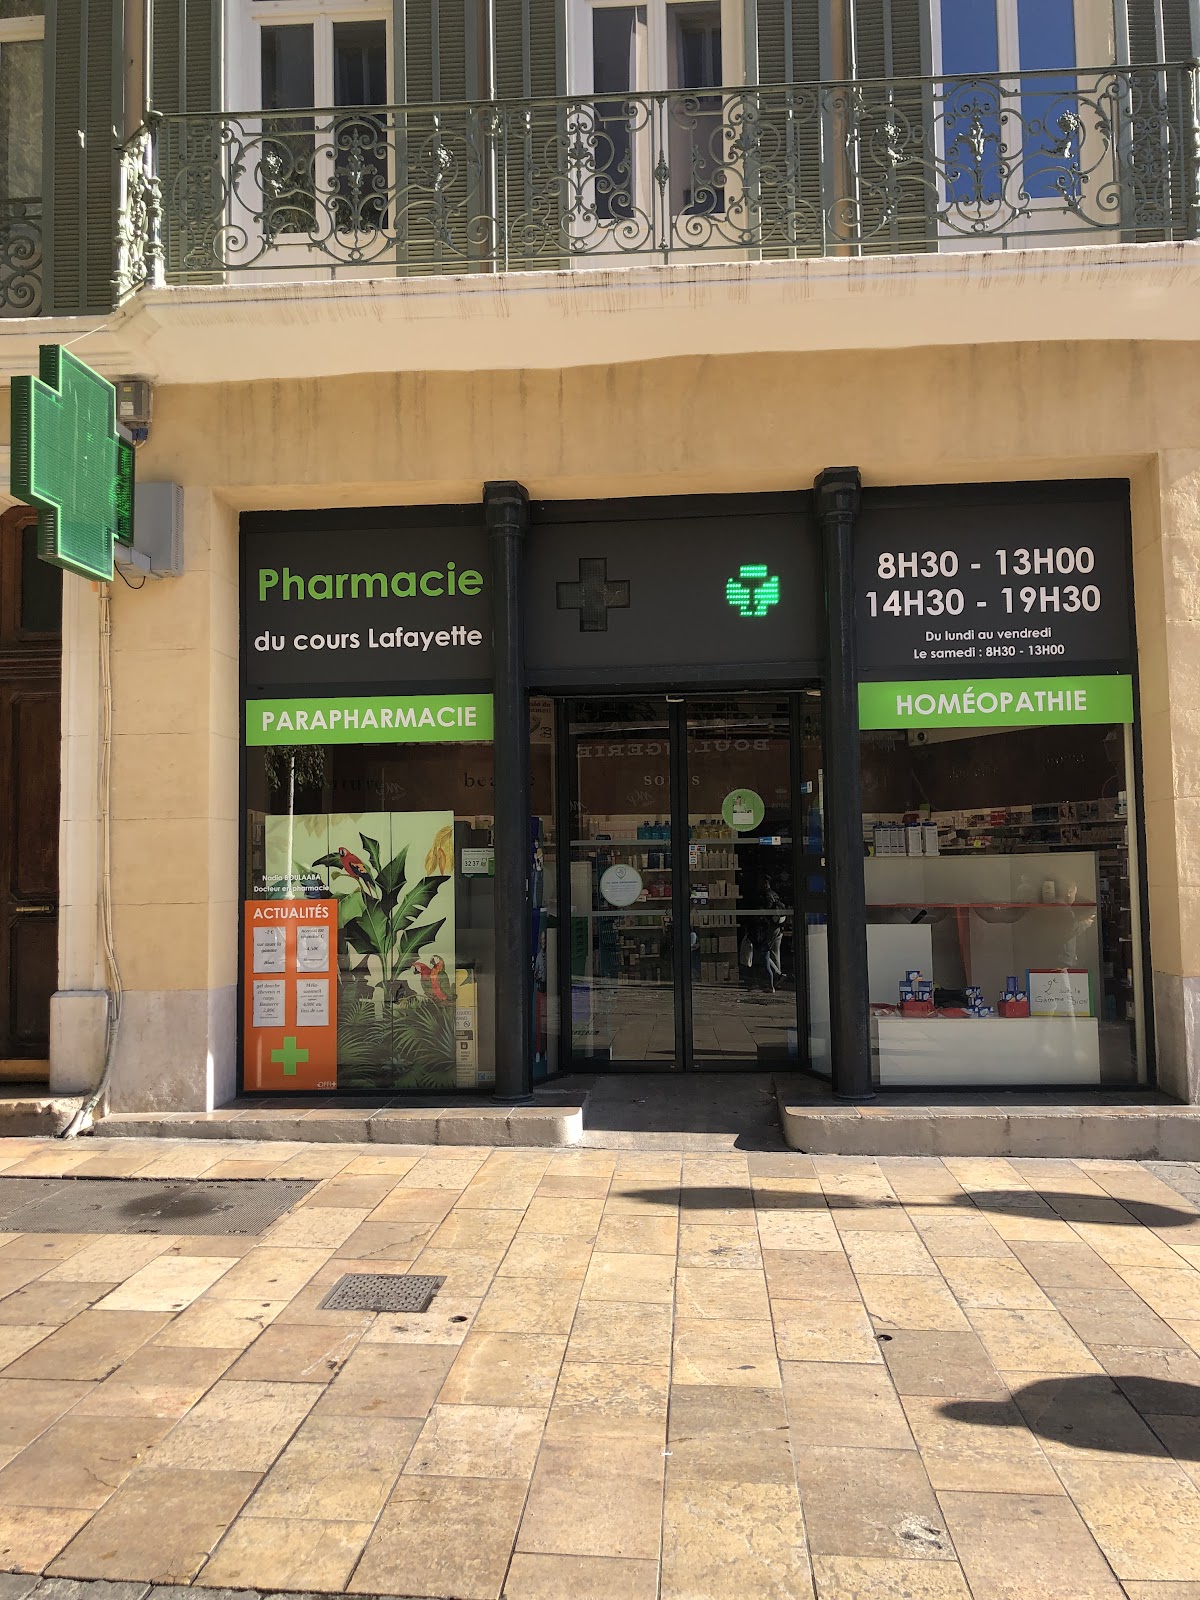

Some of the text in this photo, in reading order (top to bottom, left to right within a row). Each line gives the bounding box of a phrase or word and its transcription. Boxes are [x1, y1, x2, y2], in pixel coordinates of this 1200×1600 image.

[877, 550, 959, 579] 8H30
[995, 546, 1095, 576] 13H00
[259, 561, 484, 601] Pharmacie
[865, 588, 965, 618] 14H30
[1001, 584, 1101, 614] 19H30
[254, 625, 483, 651] du cours Lafayette
[925, 627, 1052, 642] Du lundi au vendredi
[913, 648, 928, 659] Le
[930, 646, 976, 659] samedi
[985, 646, 1016, 657] 8H30
[1028, 644, 1065, 656] 13H00
[896, 686, 1087, 716] HOMÉOPATHIE
[262, 706, 478, 731] PARAPHARMACIE
[292, 884, 330, 892] pharmacie
[253, 904, 329, 919] ACTUALITÉS
